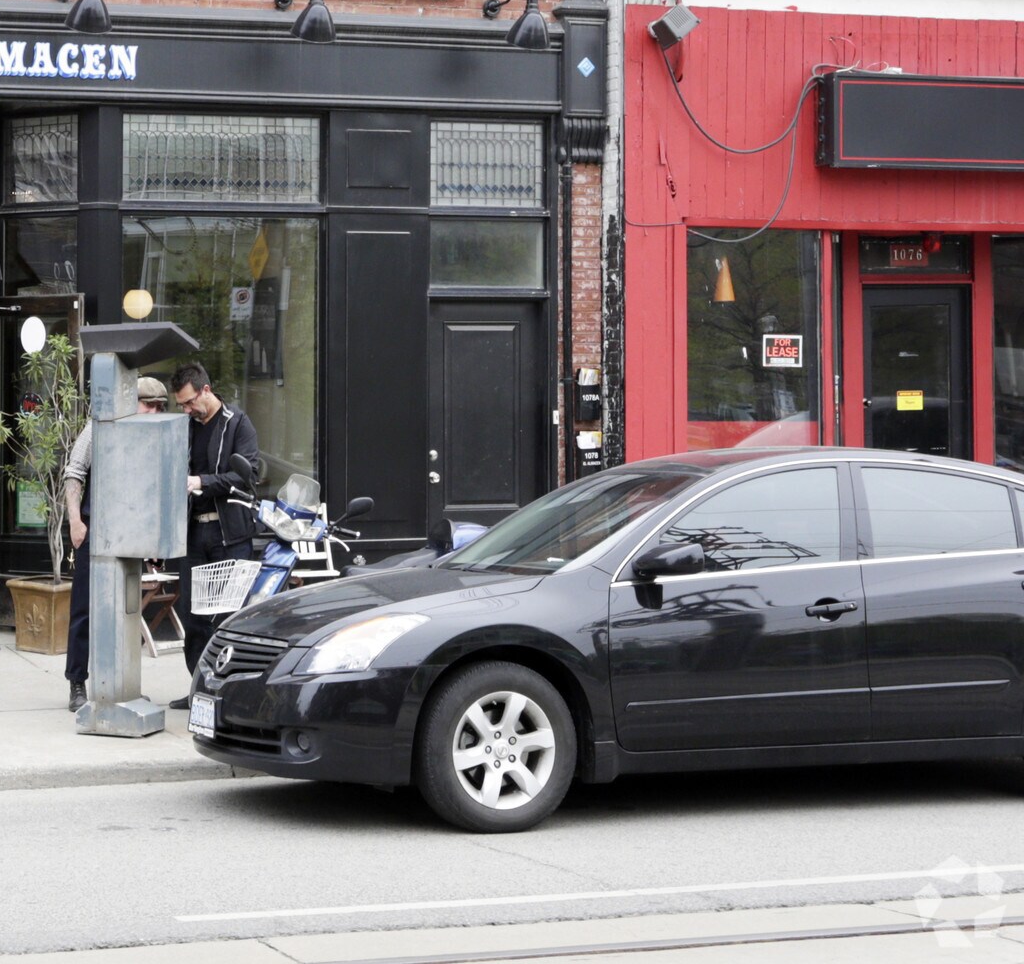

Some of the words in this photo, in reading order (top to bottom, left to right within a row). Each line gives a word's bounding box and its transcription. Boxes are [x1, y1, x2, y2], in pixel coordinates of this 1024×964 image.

[893, 248, 923, 261] 1076
[774, 338, 792, 347] FOR
[766, 346, 799, 358] LEASE
[582, 393, 601, 402] 1078A
[584, 451, 600, 460] 1078
